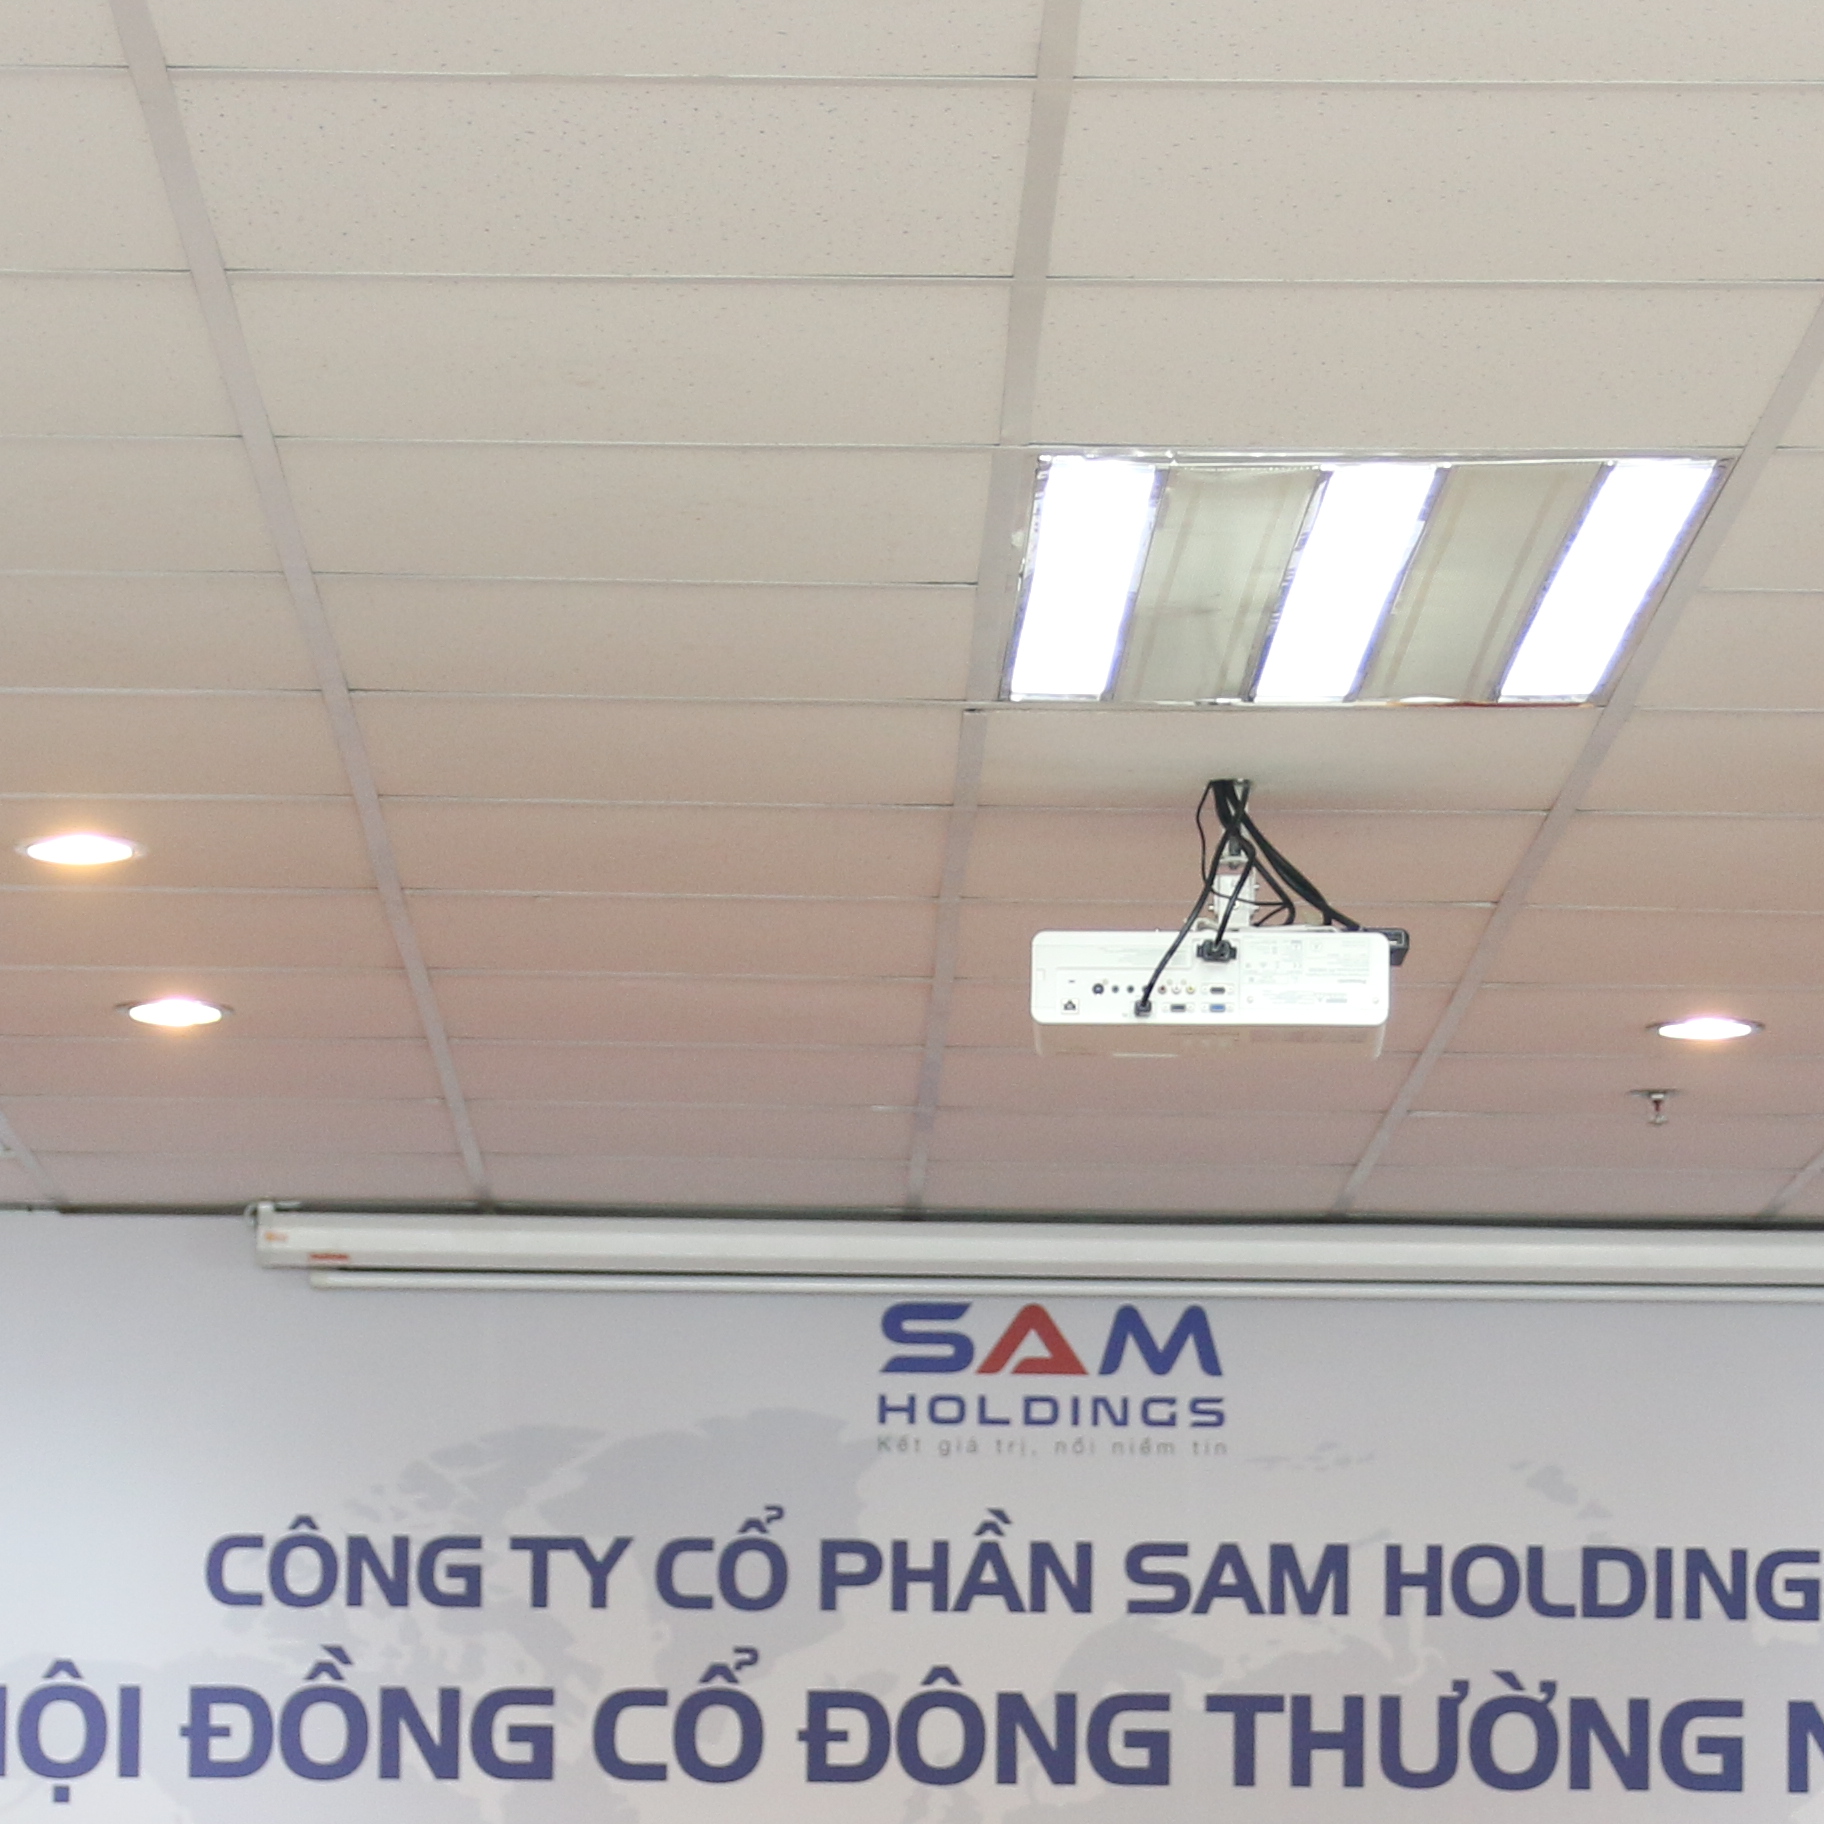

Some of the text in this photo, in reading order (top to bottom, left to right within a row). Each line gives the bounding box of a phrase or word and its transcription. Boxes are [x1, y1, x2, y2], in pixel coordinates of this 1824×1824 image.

[880, 1302, 1223, 1376] SAM
[877, 1436, 922, 1453] Kết
[937, 1436, 977, 1457] giá
[1111, 1437, 1176, 1456] niềm
[1192, 1439, 1227, 1456] tin
[878, 1394, 1226, 1427] HOLDINGS
[204, 1515, 482, 1608] CÔNG
[509, 1536, 634, 1609] TY
[655, 1506, 789, 1611] CỔ
[819, 1508, 1093, 1613] PHẦN
[1123, 1542, 1350, 1617] SAM
[179, 1646, 555, 1782] ĐỒNG
[592, 1648, 764, 1785] CỔ
[798, 1667, 1171, 1787] ĐÔNG
[1206, 1671, 1746, 1795] THƯỜNG
